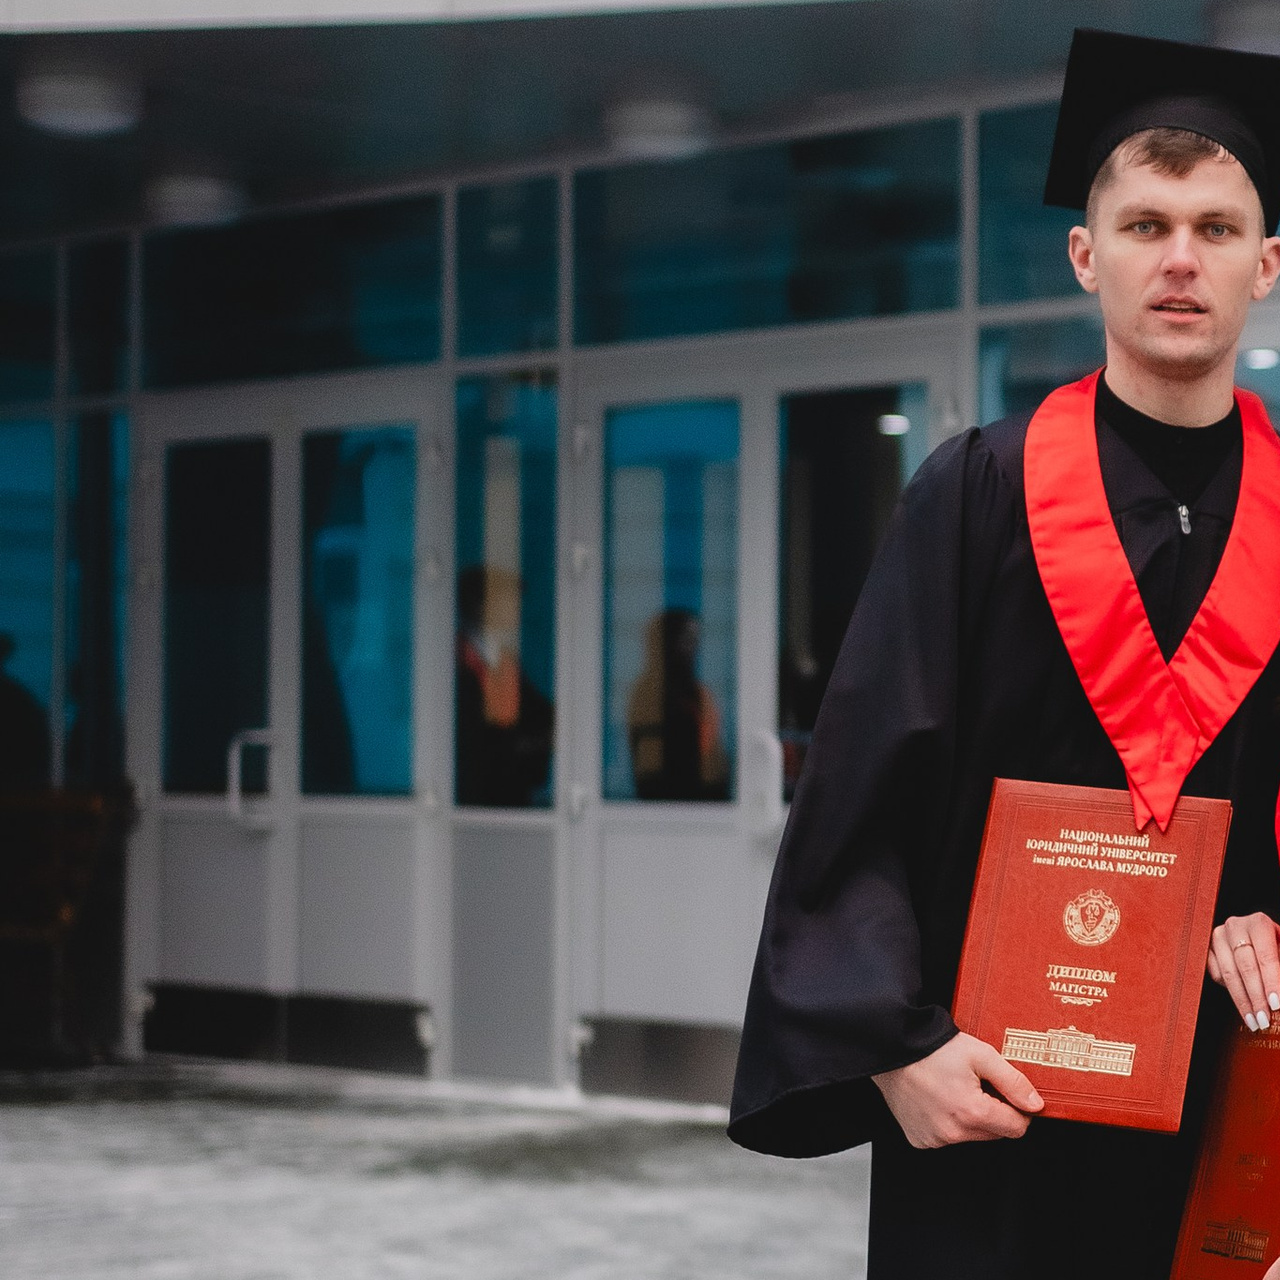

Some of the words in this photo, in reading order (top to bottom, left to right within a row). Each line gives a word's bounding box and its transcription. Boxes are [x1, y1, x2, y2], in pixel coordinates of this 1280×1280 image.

[1060, 828, 1150, 848] НАЦІОНАЛЬНИЙ
[1026, 839, 1099, 856] ЮРИДИЧНИЙ
[1100, 846, 1177, 865] УНІВЕРСИТЕТ
[1056, 856, 1114, 872] ЯРОСЛАВА
[1116, 862, 1168, 877] МУДРОГО
[1046, 964, 1117, 983] ДИПЛОМ
[1049, 981, 1109, 997] МАГІСТРА
